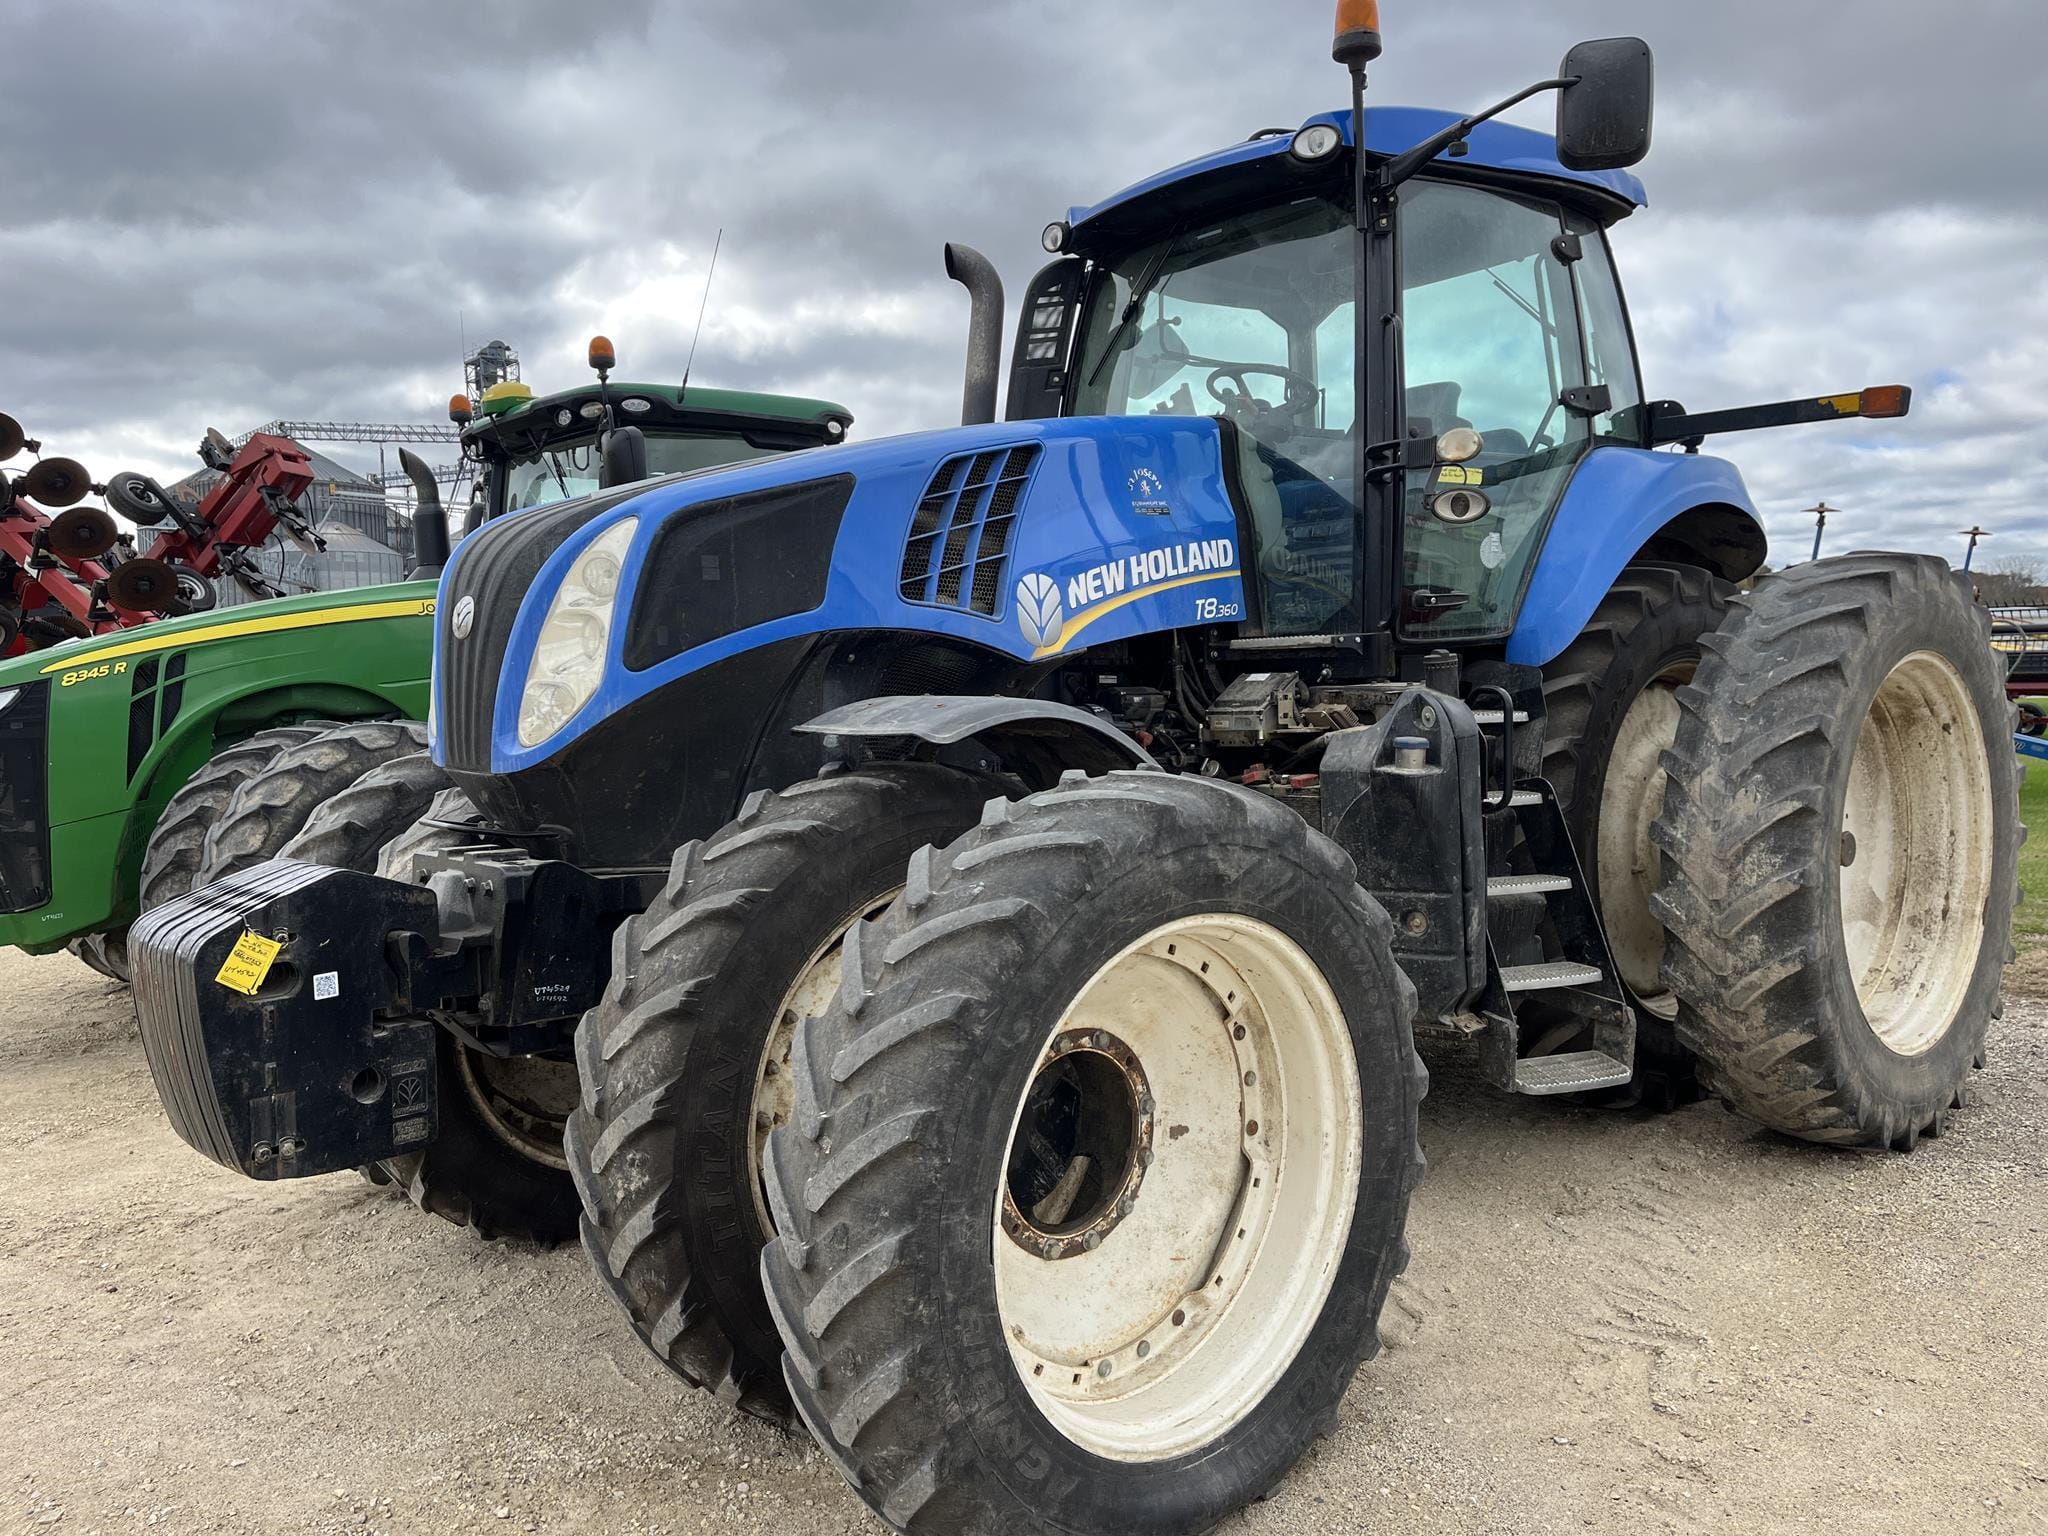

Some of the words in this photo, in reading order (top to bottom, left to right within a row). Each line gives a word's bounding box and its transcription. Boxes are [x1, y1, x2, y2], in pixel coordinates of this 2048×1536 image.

[1068, 559, 1125, 609] NEW
[1130, 539, 1234, 586] HOLLAND
[417, 602, 436, 614] JO
[1196, 598, 1238, 620] T8.360
[61, 665, 110, 687] 8345
[113, 661, 128, 675] R
[697, 1047, 743, 1255] TITAN
